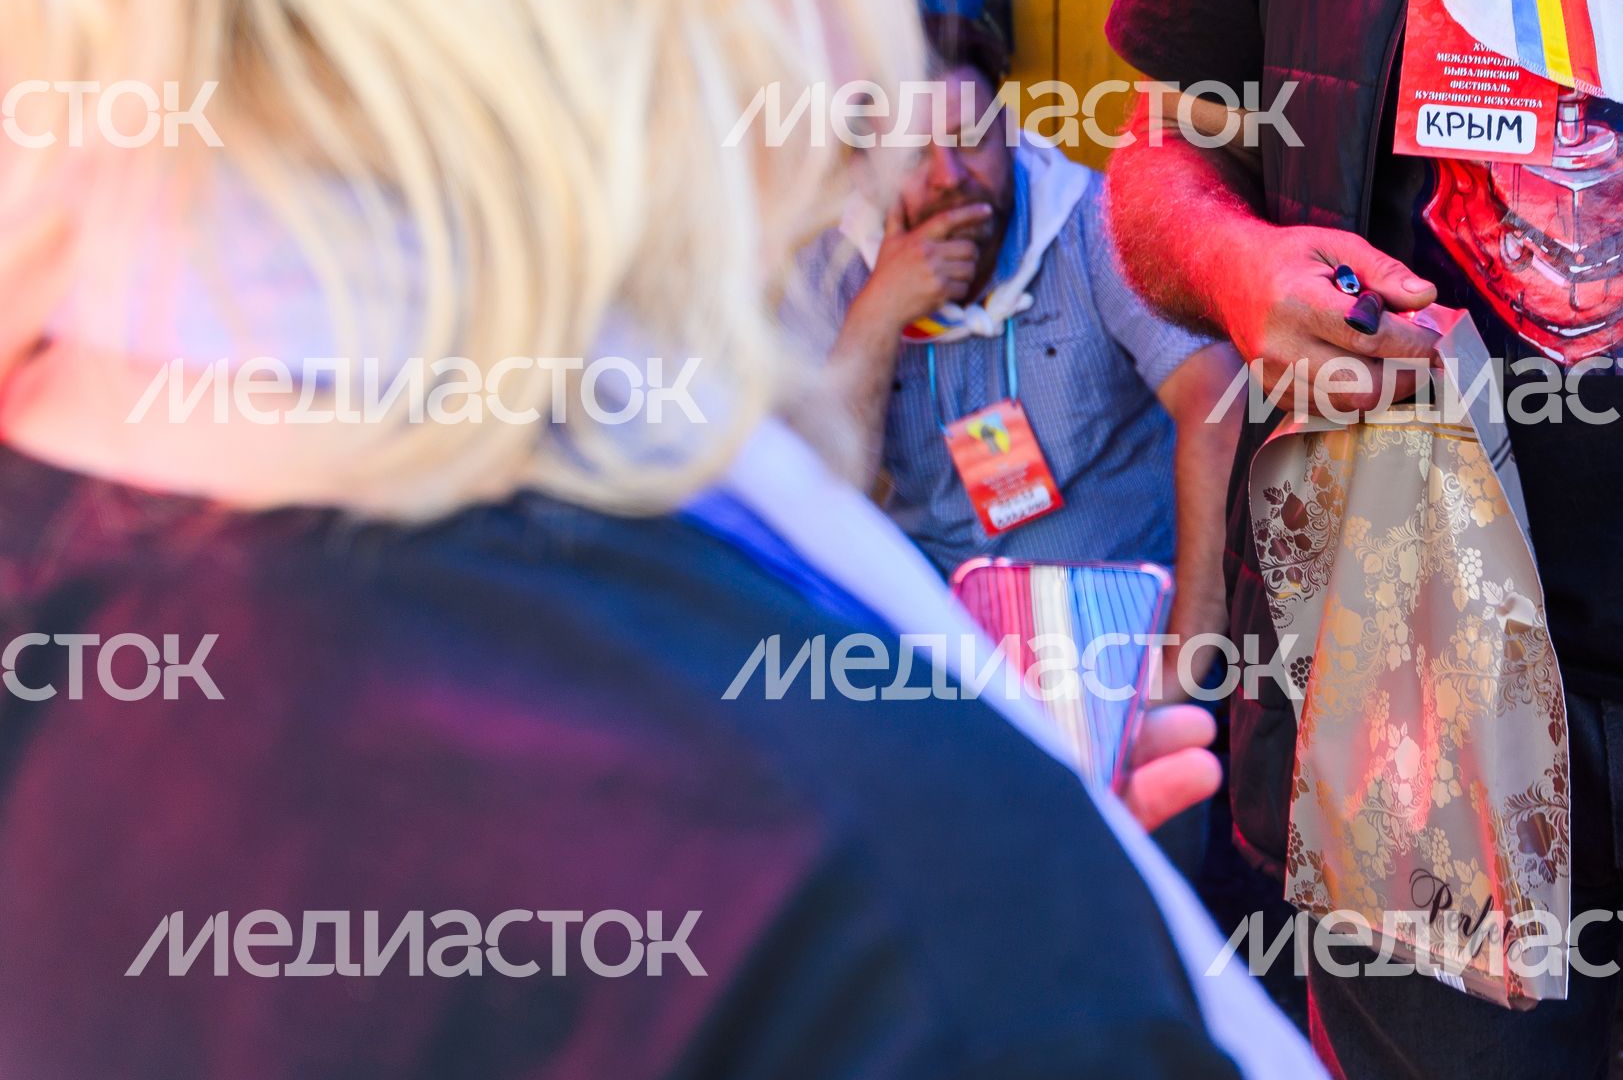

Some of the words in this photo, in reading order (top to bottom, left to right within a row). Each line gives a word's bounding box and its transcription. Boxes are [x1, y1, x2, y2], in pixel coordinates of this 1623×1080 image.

[1450, 80, 1511, 93] ФЕСТИВАЛЬ
[1414, 90, 1482, 104] КУЗНЕЧНОГО
[1483, 95, 1543, 108] ИСКУССТВА
[1426, 111, 1523, 144] КРЫМ
